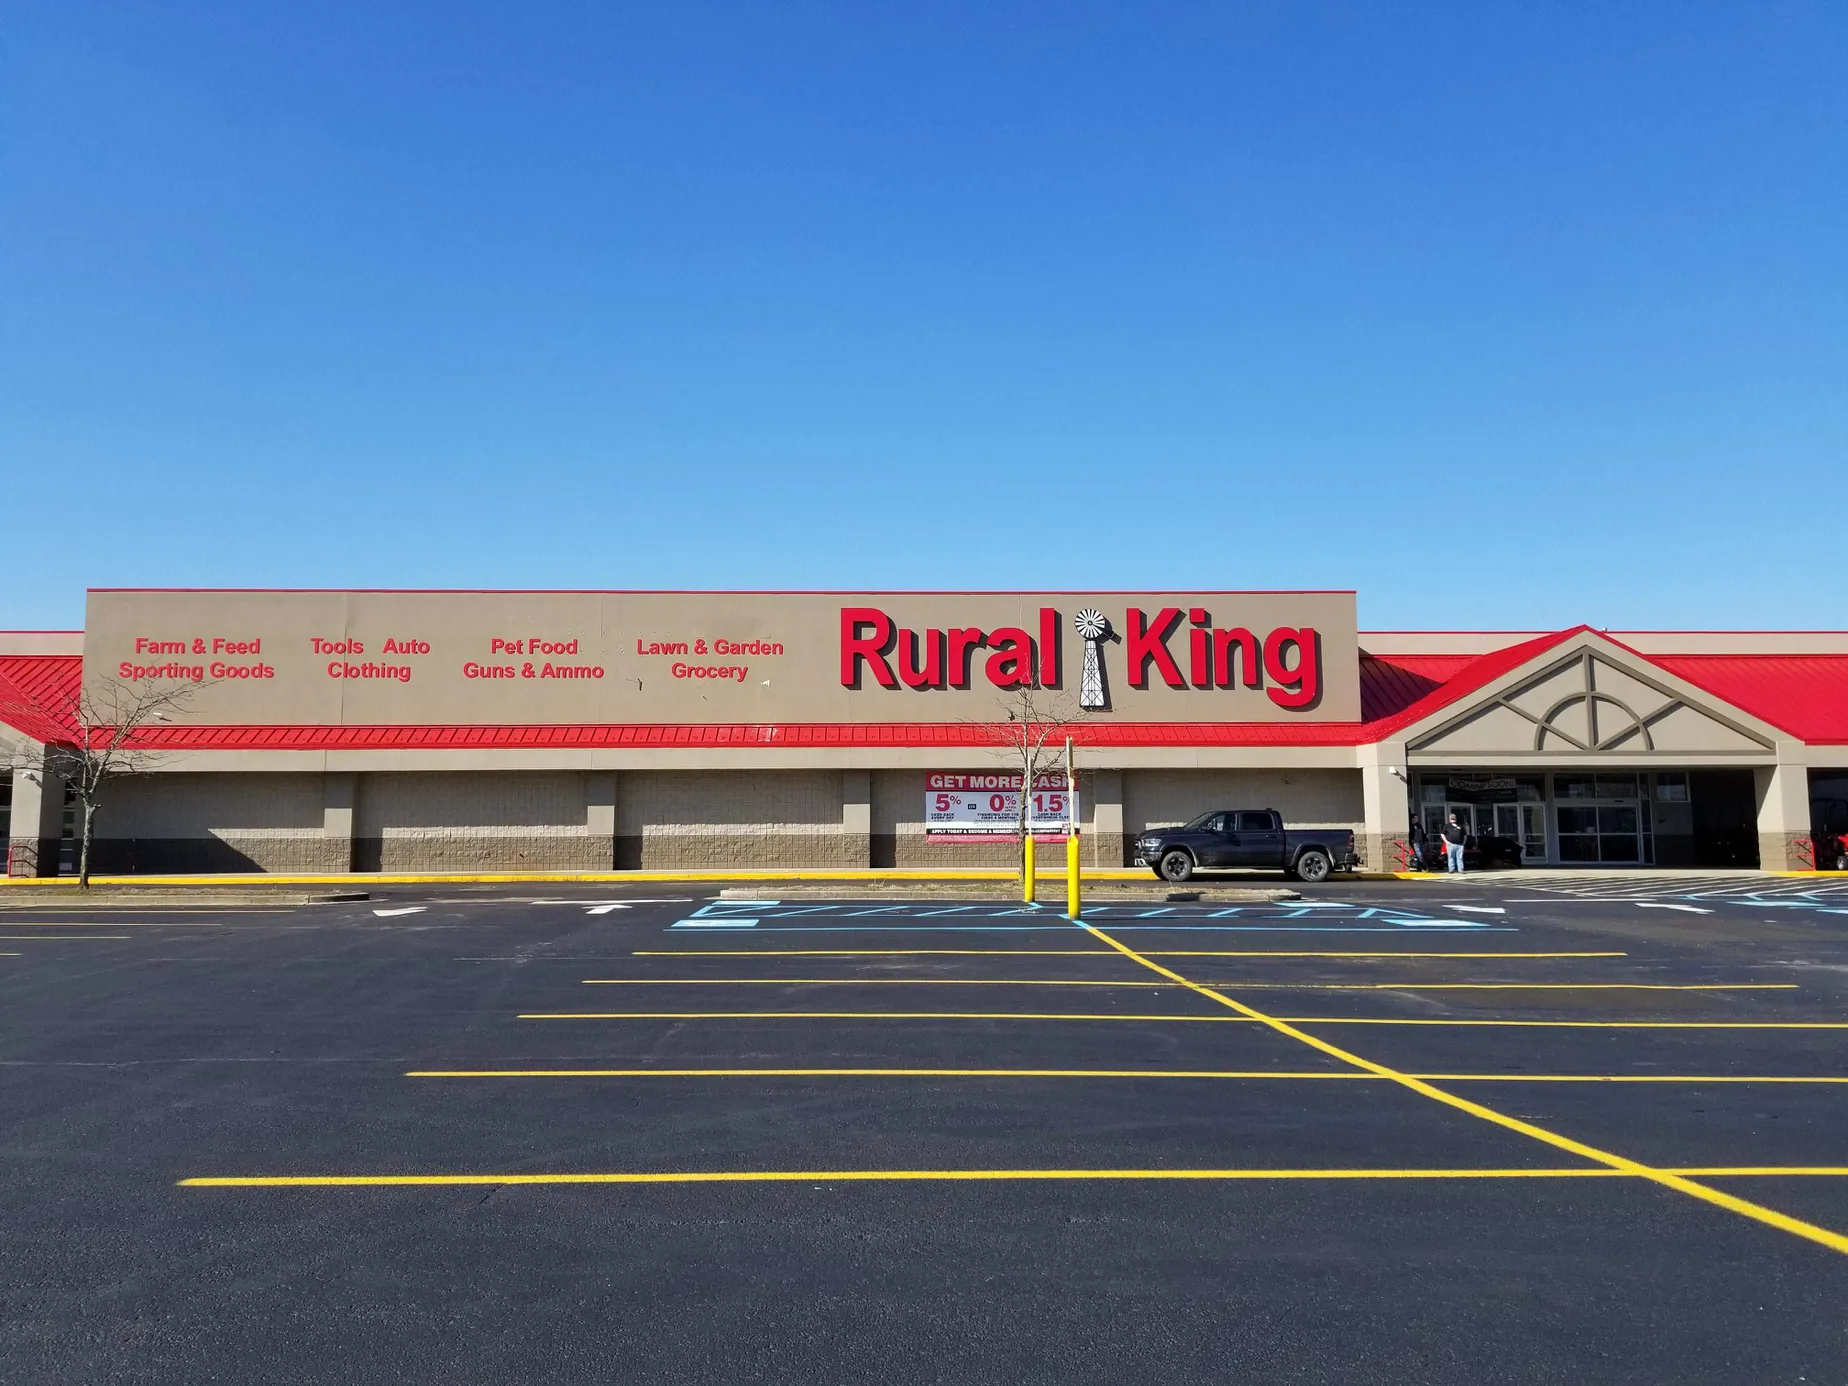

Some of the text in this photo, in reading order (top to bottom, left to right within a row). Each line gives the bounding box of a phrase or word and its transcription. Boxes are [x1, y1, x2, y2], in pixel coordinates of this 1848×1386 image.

[135, 637, 261, 655] Farm & Feed
[310, 637, 431, 655] Tools Auto
[490, 638, 579, 656] Pet Food
[637, 638, 785, 656] Lawn & Garden
[839, 606, 1321, 711] Rural King
[118, 661, 275, 683] Sporting Goods
[327, 661, 412, 683] Clothing
[462, 661, 605, 680] Guns & Ammo
[671, 662, 749, 683] Grocery
[930, 775, 966, 788] GET
[970, 775, 1021, 788] MORE
[1450, 778, 1515, 790] COMING SOON!
[936, 793, 962, 812] 5%
[989, 793, 1017, 812] 0%
